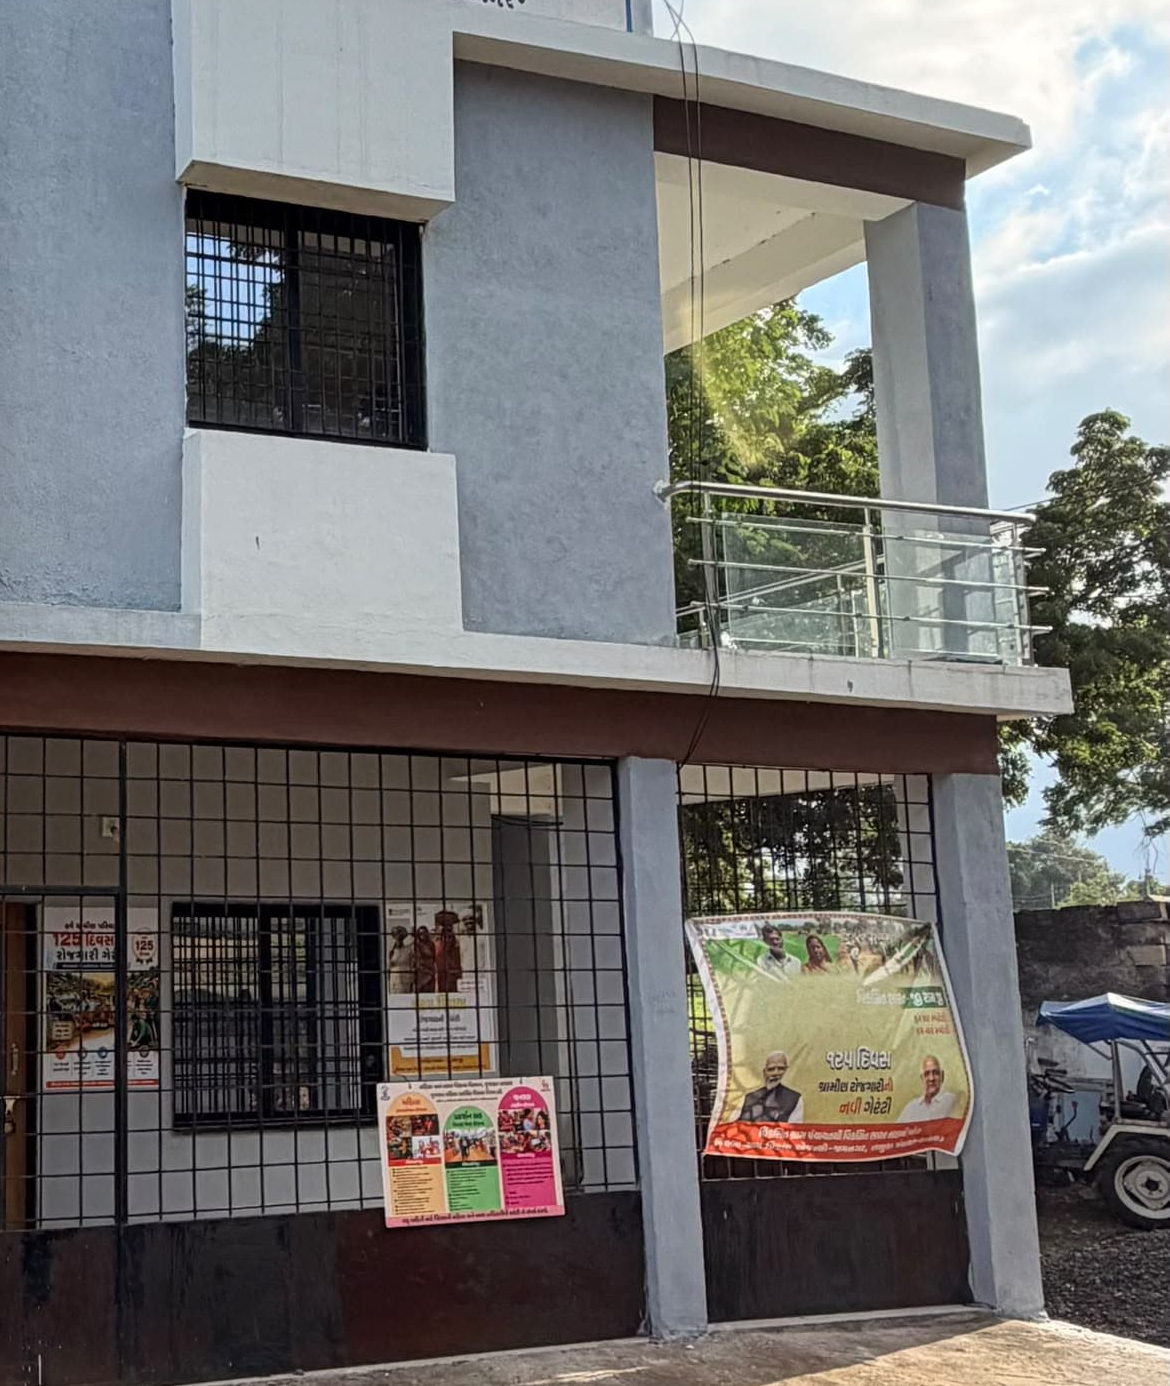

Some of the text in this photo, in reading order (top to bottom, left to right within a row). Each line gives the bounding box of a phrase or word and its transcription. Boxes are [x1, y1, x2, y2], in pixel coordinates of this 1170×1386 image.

[85, 930, 115, 948] દિવસ
[135, 940, 155, 952] 125
[825, 1045, 893, 1071] ૧૨૫ દિવસ
[838, 1096, 893, 1115] નવી ગેરંટી
